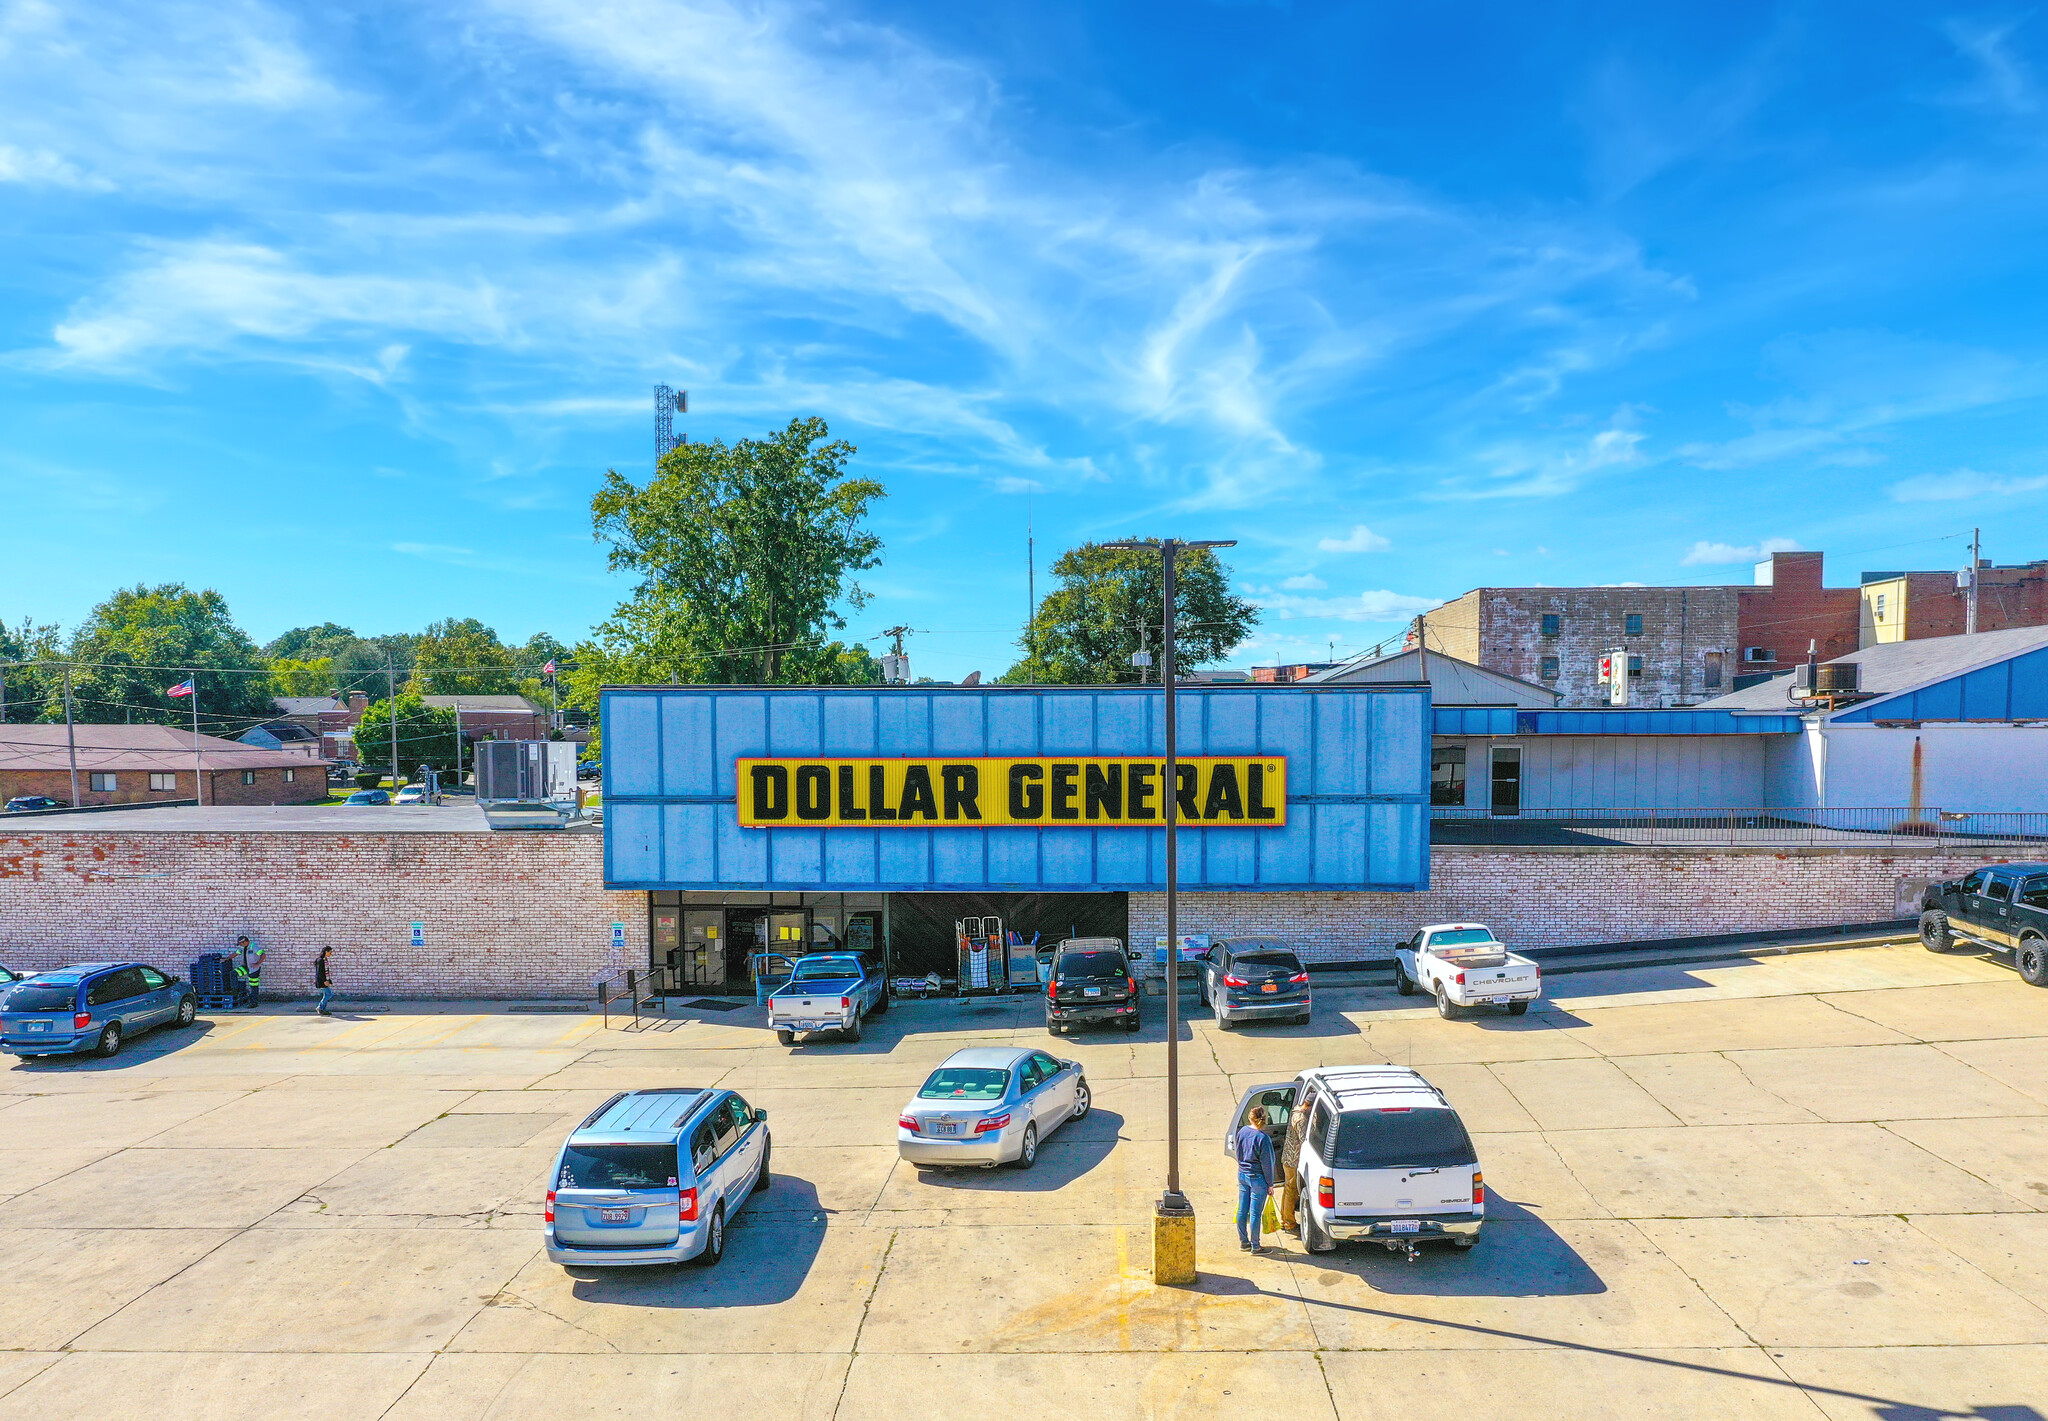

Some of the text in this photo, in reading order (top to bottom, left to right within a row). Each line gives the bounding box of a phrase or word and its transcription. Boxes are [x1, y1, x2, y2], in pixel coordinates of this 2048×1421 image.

[750, 763, 1276, 821] DOLLAR GENERAL
[1473, 976, 1529, 986] CHEVROLET
